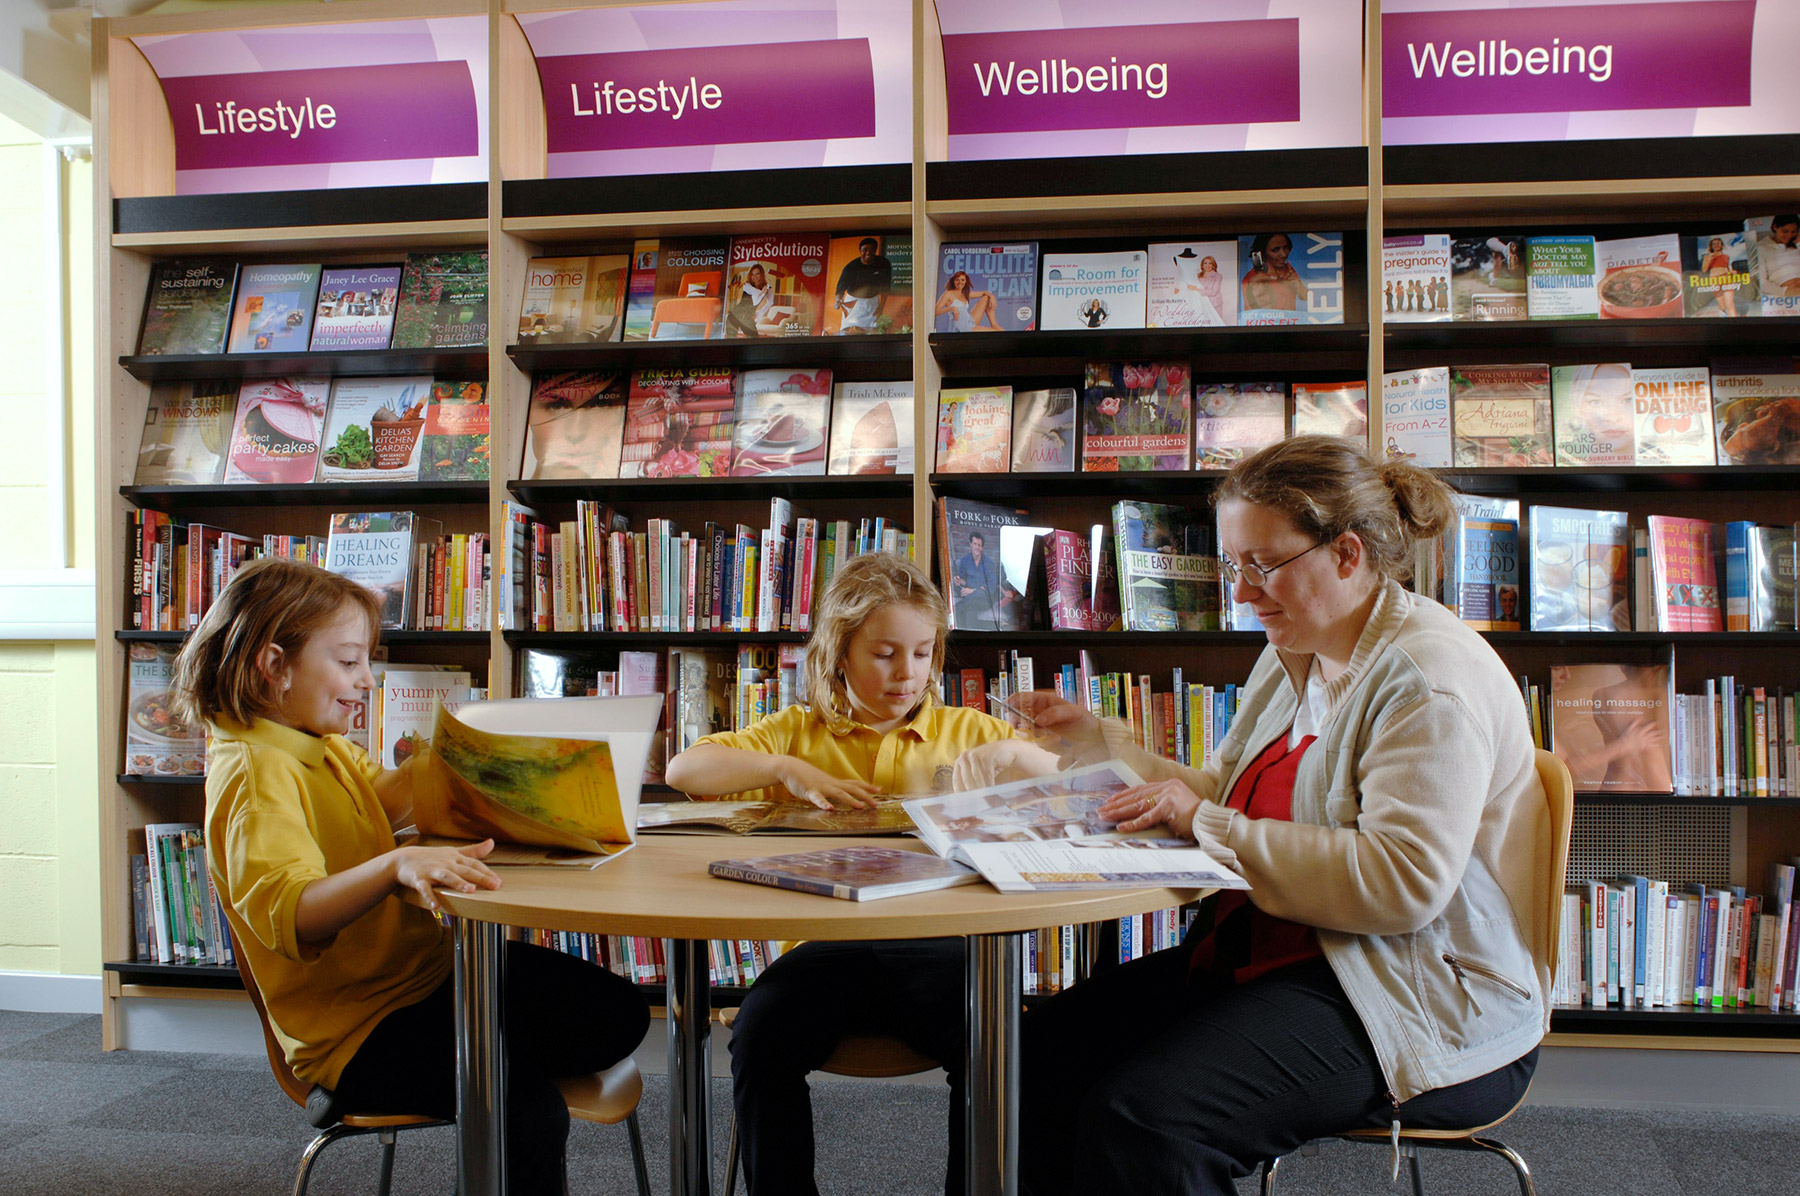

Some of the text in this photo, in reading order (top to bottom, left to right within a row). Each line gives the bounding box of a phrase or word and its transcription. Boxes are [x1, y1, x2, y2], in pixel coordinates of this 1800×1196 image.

[1407, 38, 1613, 82] Wellbeing
[974, 56, 1169, 100] Wellbeing
[571, 76, 723, 120] Lifestyle
[195, 97, 337, 139] Lifestyle
[1532, 246, 1582, 254] WHAT YOUR
[667, 255, 724, 267] COLOURS
[943, 253, 1034, 274] CELLULITE
[1384, 256, 1448, 270] pregnancy
[186, 266, 214, 277] self-
[250, 271, 312, 283] Homeopathy
[1077, 266, 1140, 280] Room for
[161, 277, 224, 289] sustaining
[325, 273, 395, 286] Janey Lee Grace
[530, 271, 583, 287] home
[1532, 274, 1594, 289] FIBROMYALGIA
[1690, 272, 1750, 287] Running
[988, 277, 1032, 298] PLAN
[1049, 282, 1139, 298] Improvement
[1697, 283, 1742, 292] made easy
[1151, 304, 1195, 317] Wedding
[1476, 304, 1525, 317] Running
[320, 321, 386, 337] imperfectly
[436, 322, 487, 334] climbing
[1279, 318, 1298, 326] FIT
[435, 330, 486, 344] gardens
[639, 367, 731, 379] TRICIA GUILD
[1633, 373, 1672, 382] Everyone's
[701, 378, 730, 386] COLOUR
[1716, 377, 1763, 387] arthritis
[848, 389, 908, 398] Trish McEvoy
[1385, 390, 1415, 399] Natural
[1634, 381, 1705, 398] ONLINE
[1738, 386, 1795, 396] cooking for
[1385, 398, 1446, 414] for Kids
[1460, 402, 1528, 421] Adriana
[1635, 398, 1707, 414] DATING
[162, 408, 221, 419] WINDOWS
[964, 415, 994, 429] great
[1385, 418, 1447, 433] From A-Z
[238, 434, 269, 443] perfect
[381, 428, 412, 436] DELIA'S
[375, 436, 415, 444] KITCHEN
[1087, 436, 1186, 450] colourful gardens
[234, 442, 315, 457] party cakes
[374, 444, 413, 453] GARDEN
[954, 510, 981, 522] FORK
[991, 515, 1019, 525] FORK
[335, 538, 400, 551] HEALING
[714, 535, 722, 561] Choices
[334, 553, 398, 567] DREAMS
[1062, 545, 1111, 565] PLAT
[1132, 553, 1215, 573] THE EASY GARDEN
[1464, 556, 1515, 572] GOOD
[133, 559, 142, 595] FIRSTS
[1062, 608, 1118, 622] 2005-2006
[136, 665, 157, 676] THE
[1091, 679, 1101, 717] WHAT TO
[1556, 697, 1663, 708] healing massage
[713, 866, 779, 886] GARDEN COLOUR
[133, 881, 142, 900] Vegan
